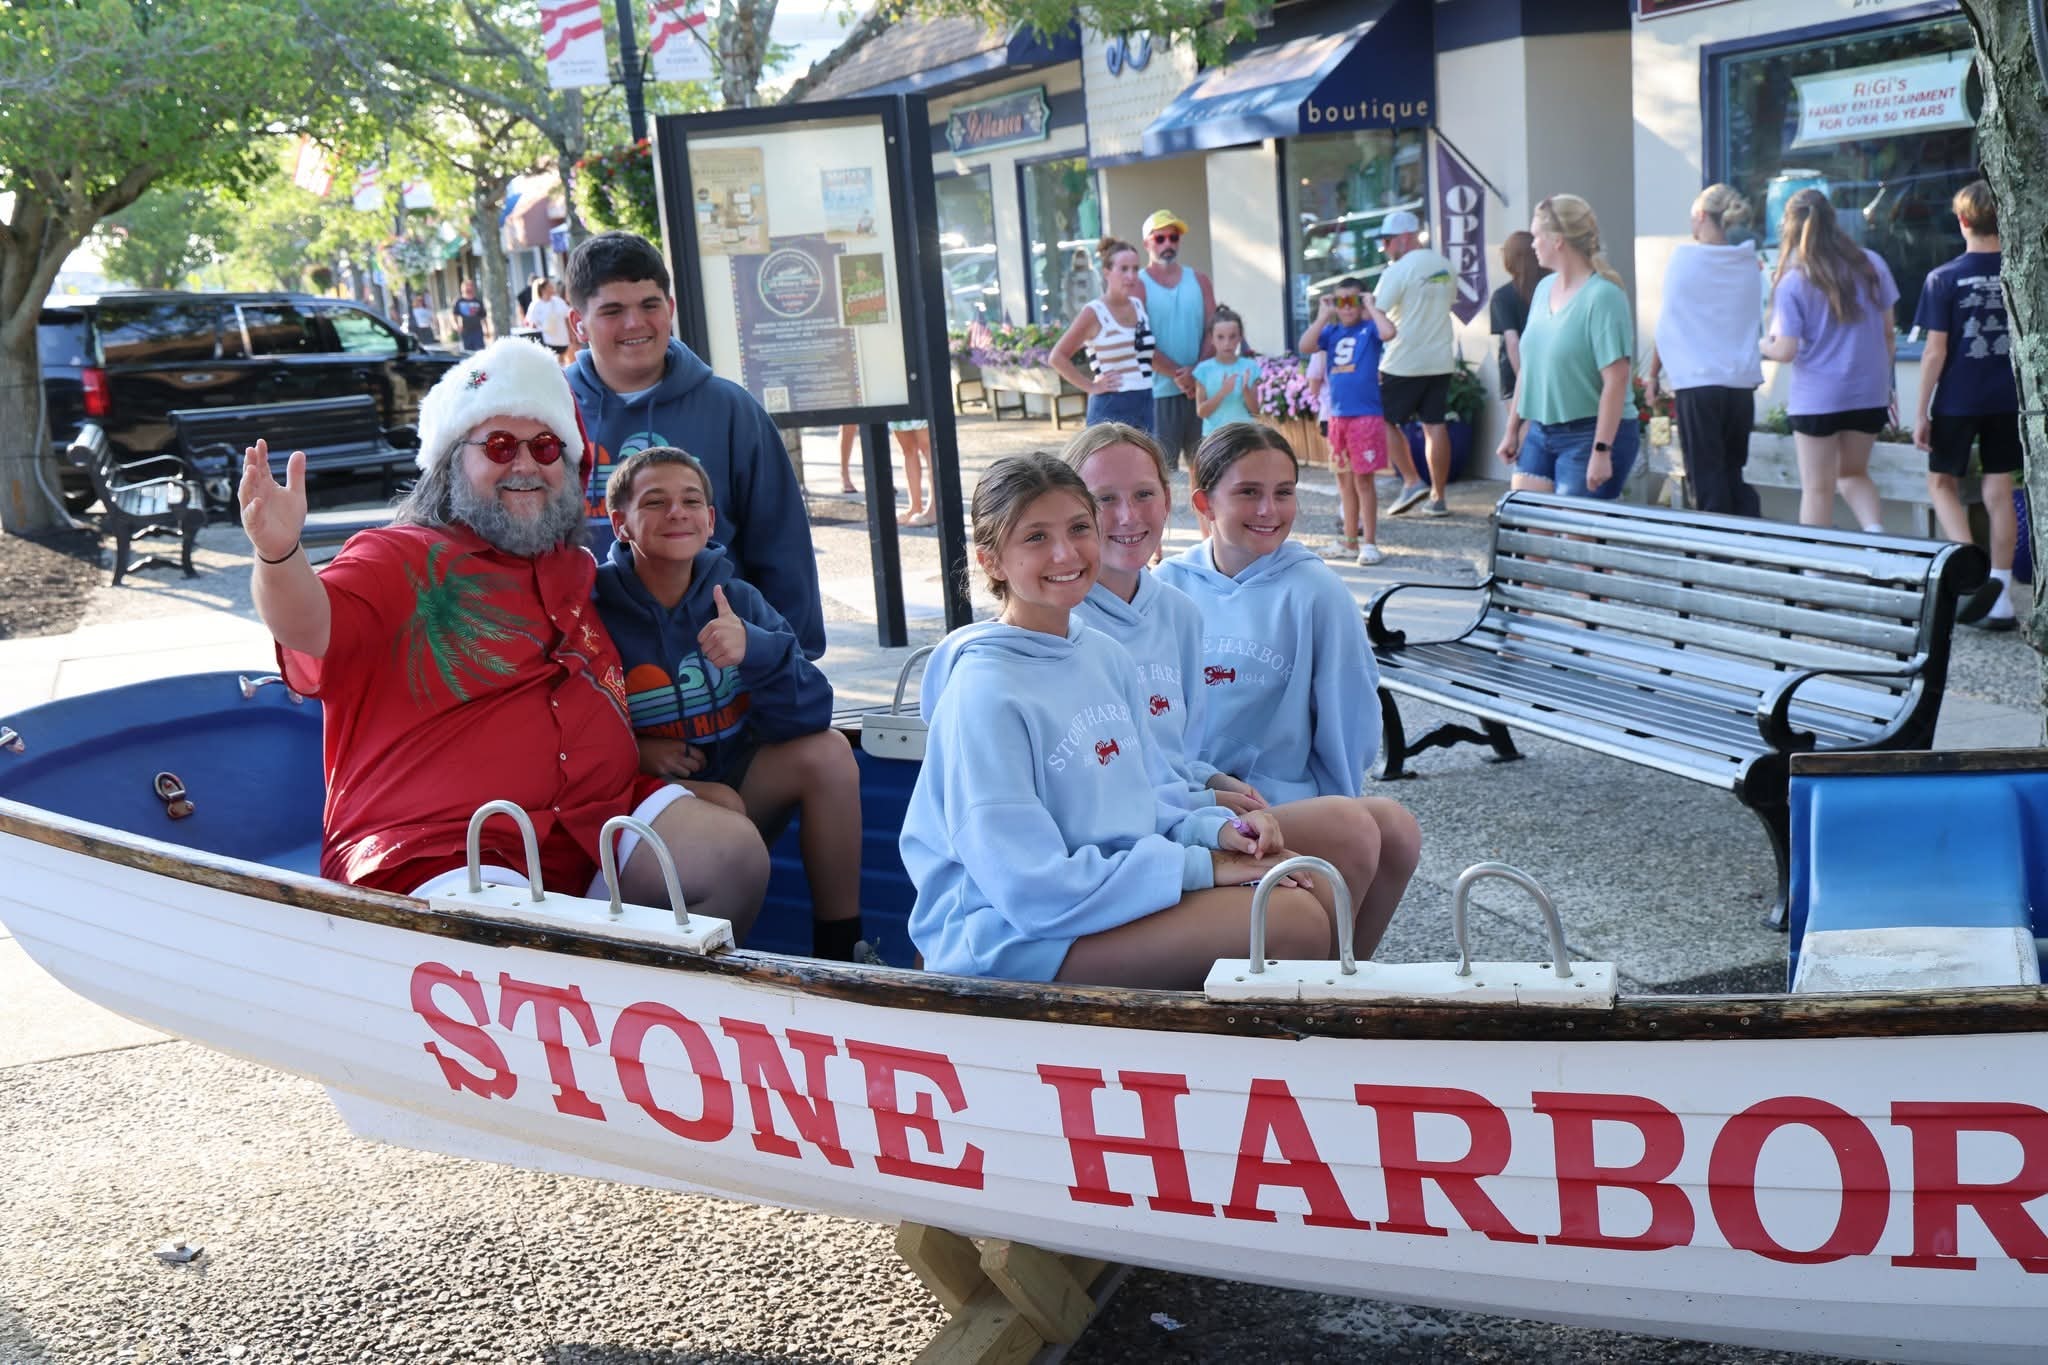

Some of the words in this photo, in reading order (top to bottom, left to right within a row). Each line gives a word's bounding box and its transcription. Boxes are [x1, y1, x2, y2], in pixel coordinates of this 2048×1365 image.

[1307, 98, 1429, 123] boutique
[1808, 104, 1848, 118] FAMILY
[1852, 87, 1957, 112] ENTERTAINMENT
[1819, 118, 1842, 130] FOR
[1847, 113, 1879, 128] OVER
[1884, 111, 1898, 123] 50
[1902, 104, 1945, 120] YEARS
[1446, 184, 1480, 303] OPEN
[1333, 337, 1356, 365] S
[410, 962, 984, 1190] STONE
[1037, 1064, 2048, 1274] HARBOR
